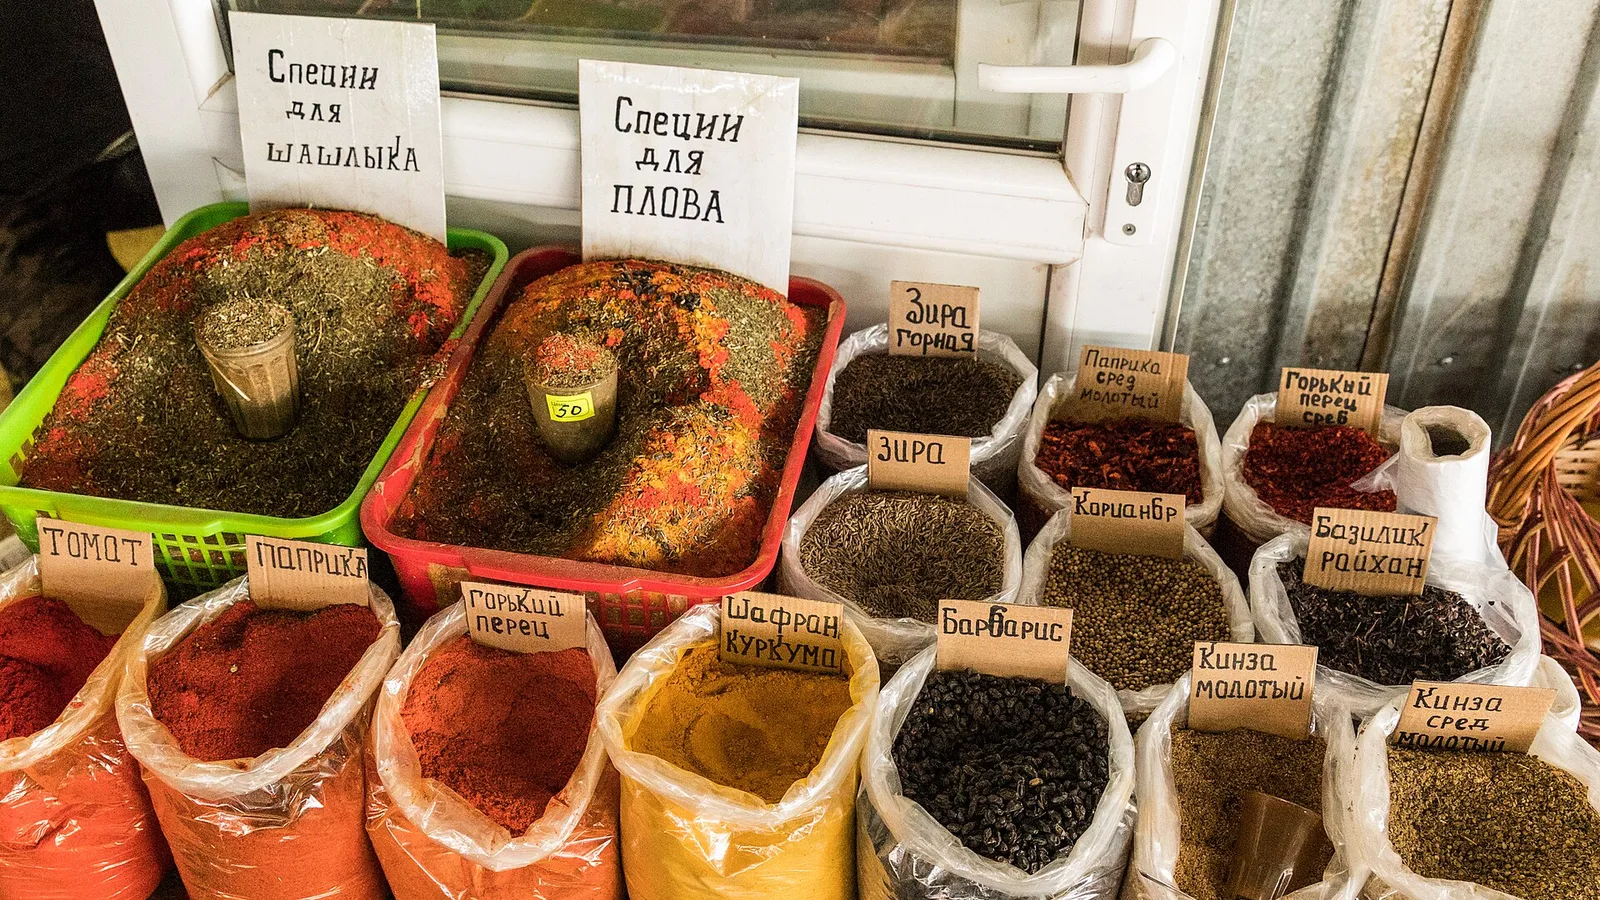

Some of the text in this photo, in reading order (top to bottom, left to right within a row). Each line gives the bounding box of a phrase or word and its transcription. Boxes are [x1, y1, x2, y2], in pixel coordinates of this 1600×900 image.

[268, 49, 379, 90] Специи
[285, 101, 342, 123] для
[615, 96, 745, 142] Специи
[635, 148, 705, 175] для
[610, 184, 725, 223] ПЛОВА
[905, 287, 971, 329] Зира
[1085, 349, 1162, 375] Паприка
[1096, 371, 1136, 391] сред
[555, 404, 582, 418] 50
[1079, 388, 1160, 409] молотый
[1299, 393, 1357, 412] перец
[1315, 515, 1430, 547] Базилик
[1321, 549, 1426, 579] райхан
[476, 615, 550, 640] перец
[725, 595, 839, 639] Шафран
[942, 604, 1063, 642] Барбарис
[1198, 641, 1278, 671] Кинза
[1195, 675, 1305, 700] молотый
[1412, 687, 1503, 712] Кинза
[1426, 715, 1490, 731] сред
